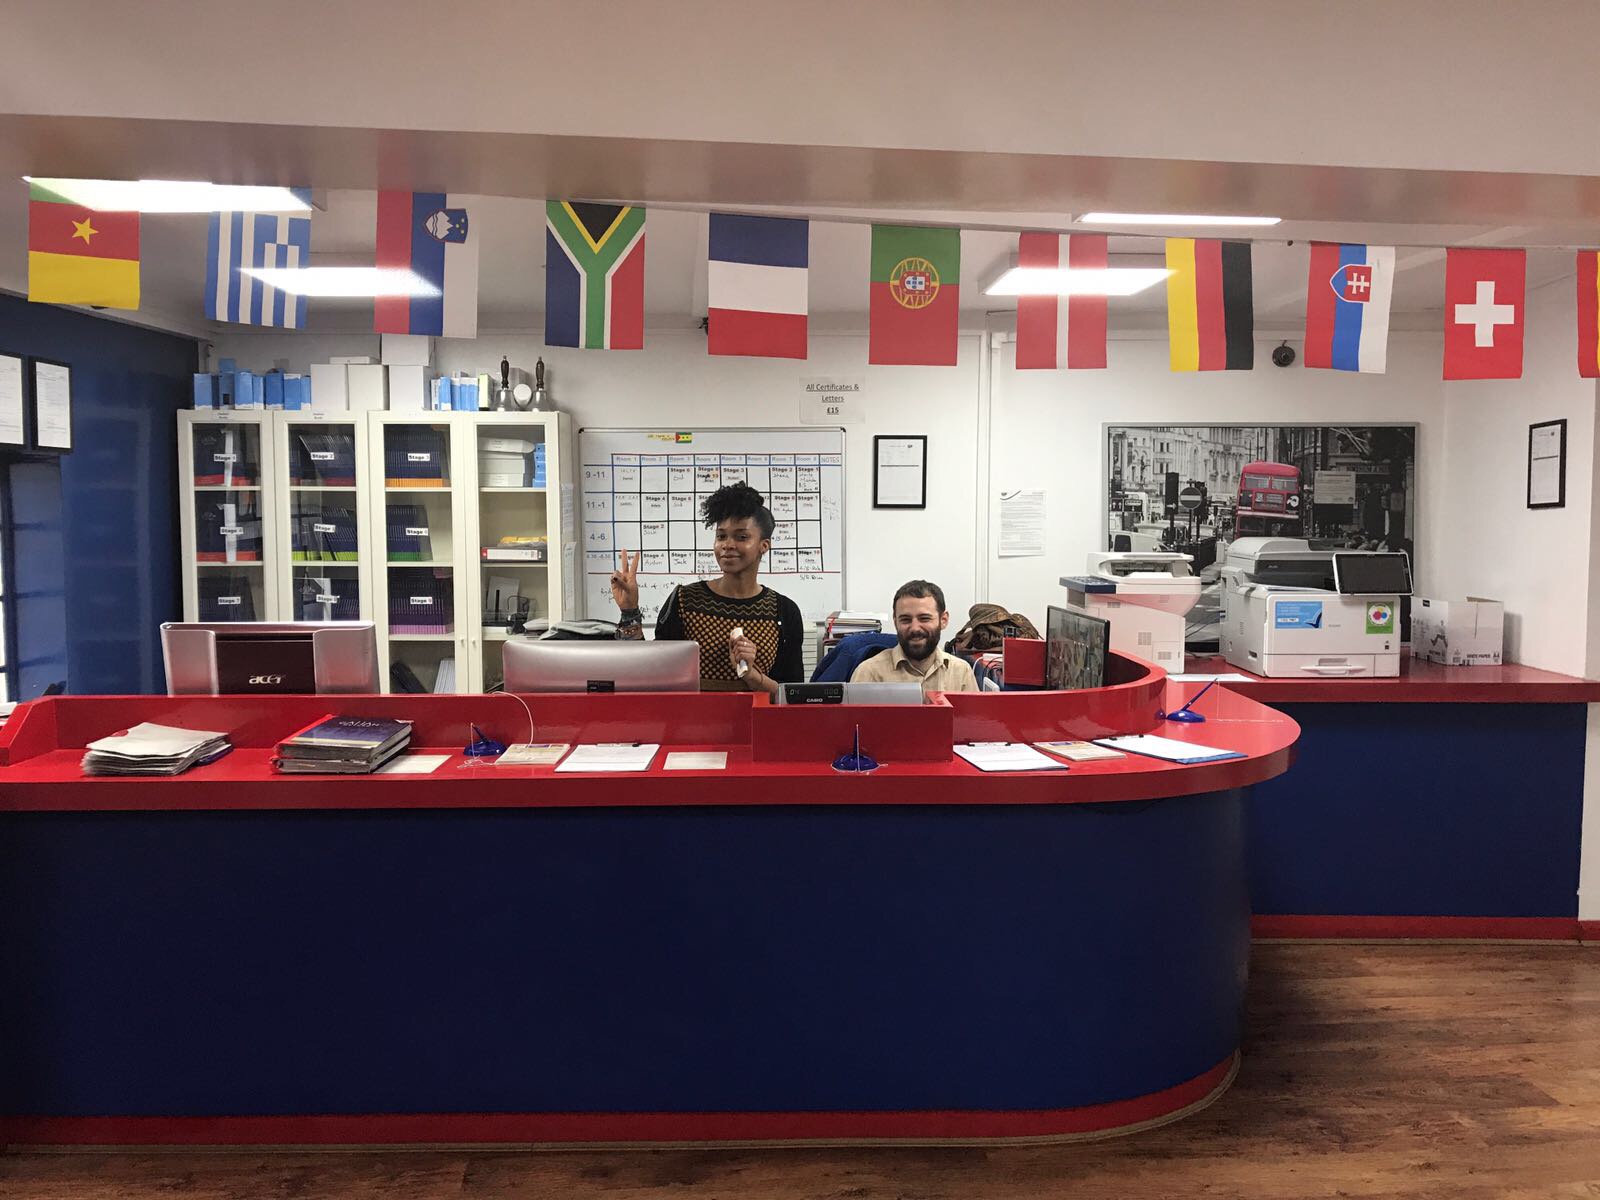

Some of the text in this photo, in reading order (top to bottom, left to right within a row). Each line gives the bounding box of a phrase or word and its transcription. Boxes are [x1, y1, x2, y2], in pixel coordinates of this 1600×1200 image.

[806, 384, 860, 392] All Certificates &
[821, 395, 845, 403] Letters
[826, 407, 840, 415] £15
[249, 675, 282, 684] acer
